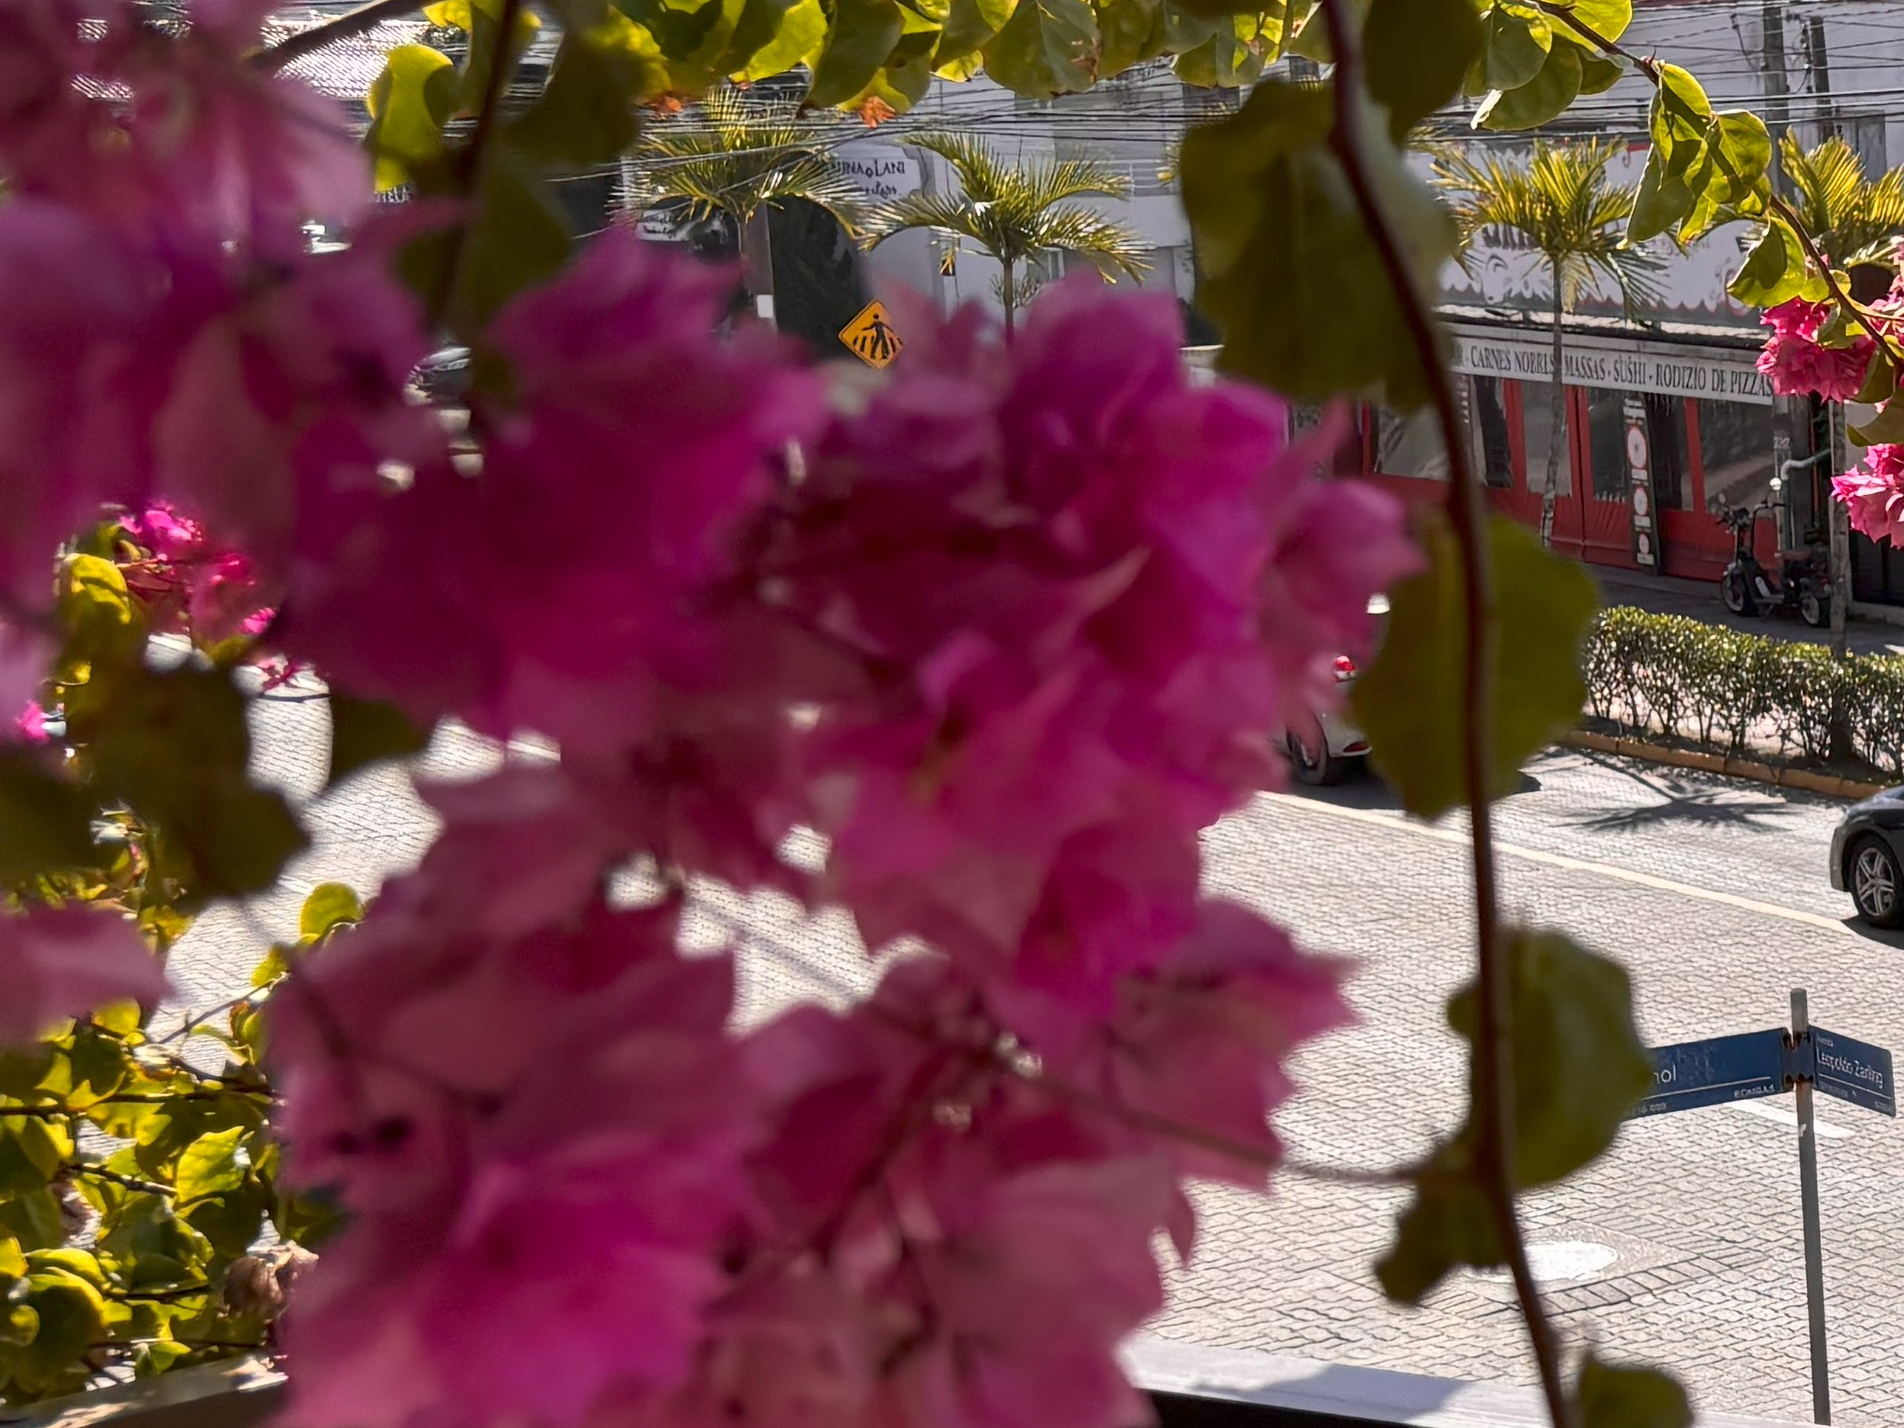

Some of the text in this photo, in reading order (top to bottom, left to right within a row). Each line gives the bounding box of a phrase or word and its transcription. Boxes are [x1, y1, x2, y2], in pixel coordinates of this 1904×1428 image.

[1470, 345, 1511, 372] CARNES
[1564, 354, 1606, 381] MASSAS
[1711, 368, 1728, 392] DE
[1730, 371, 1773, 397] PIZZAS
